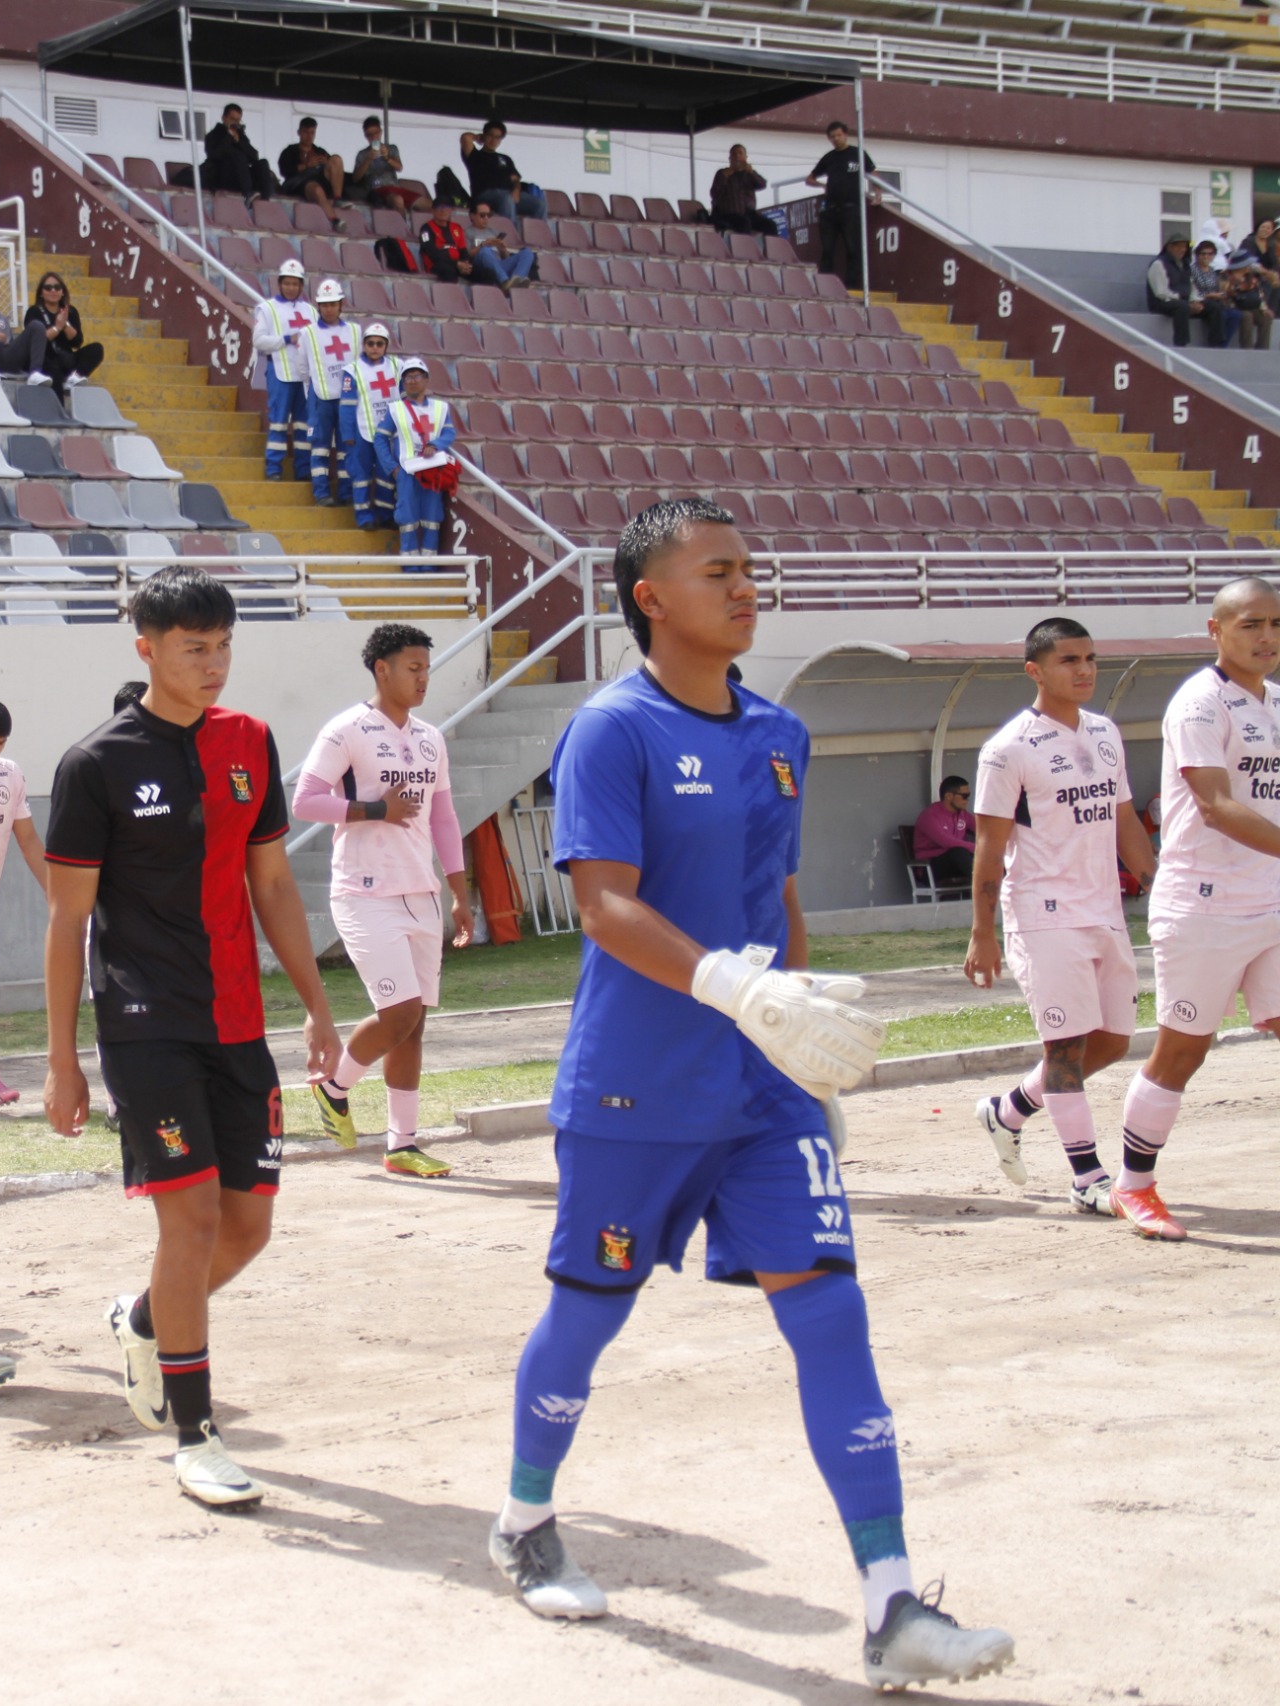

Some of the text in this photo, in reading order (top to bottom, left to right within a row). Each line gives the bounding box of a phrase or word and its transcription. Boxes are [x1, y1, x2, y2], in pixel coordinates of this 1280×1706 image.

[32, 166, 43, 198] 9
[78, 204, 91, 238] 8
[876, 227, 900, 254] 10
[128, 246, 140, 279] 7
[943, 259, 957, 286] 9
[997, 290, 1012, 318] 8
[1050, 324, 1066, 354] 7
[1113, 361, 1130, 391] 6
[1172, 394, 1189, 425] 5
[1242, 434, 1262, 464] 4
[452, 519, 468, 555] 2
[379, 767, 437, 788] apuesta
[673, 781, 714, 796] walon
[133, 804, 171, 818] walon
[399, 788, 425, 805] otal
[1073, 801, 1113, 825] total
[267, 1086, 283, 1137] 6
[797, 1136, 843, 1198] 12
[813, 1231, 850, 1246] walon
